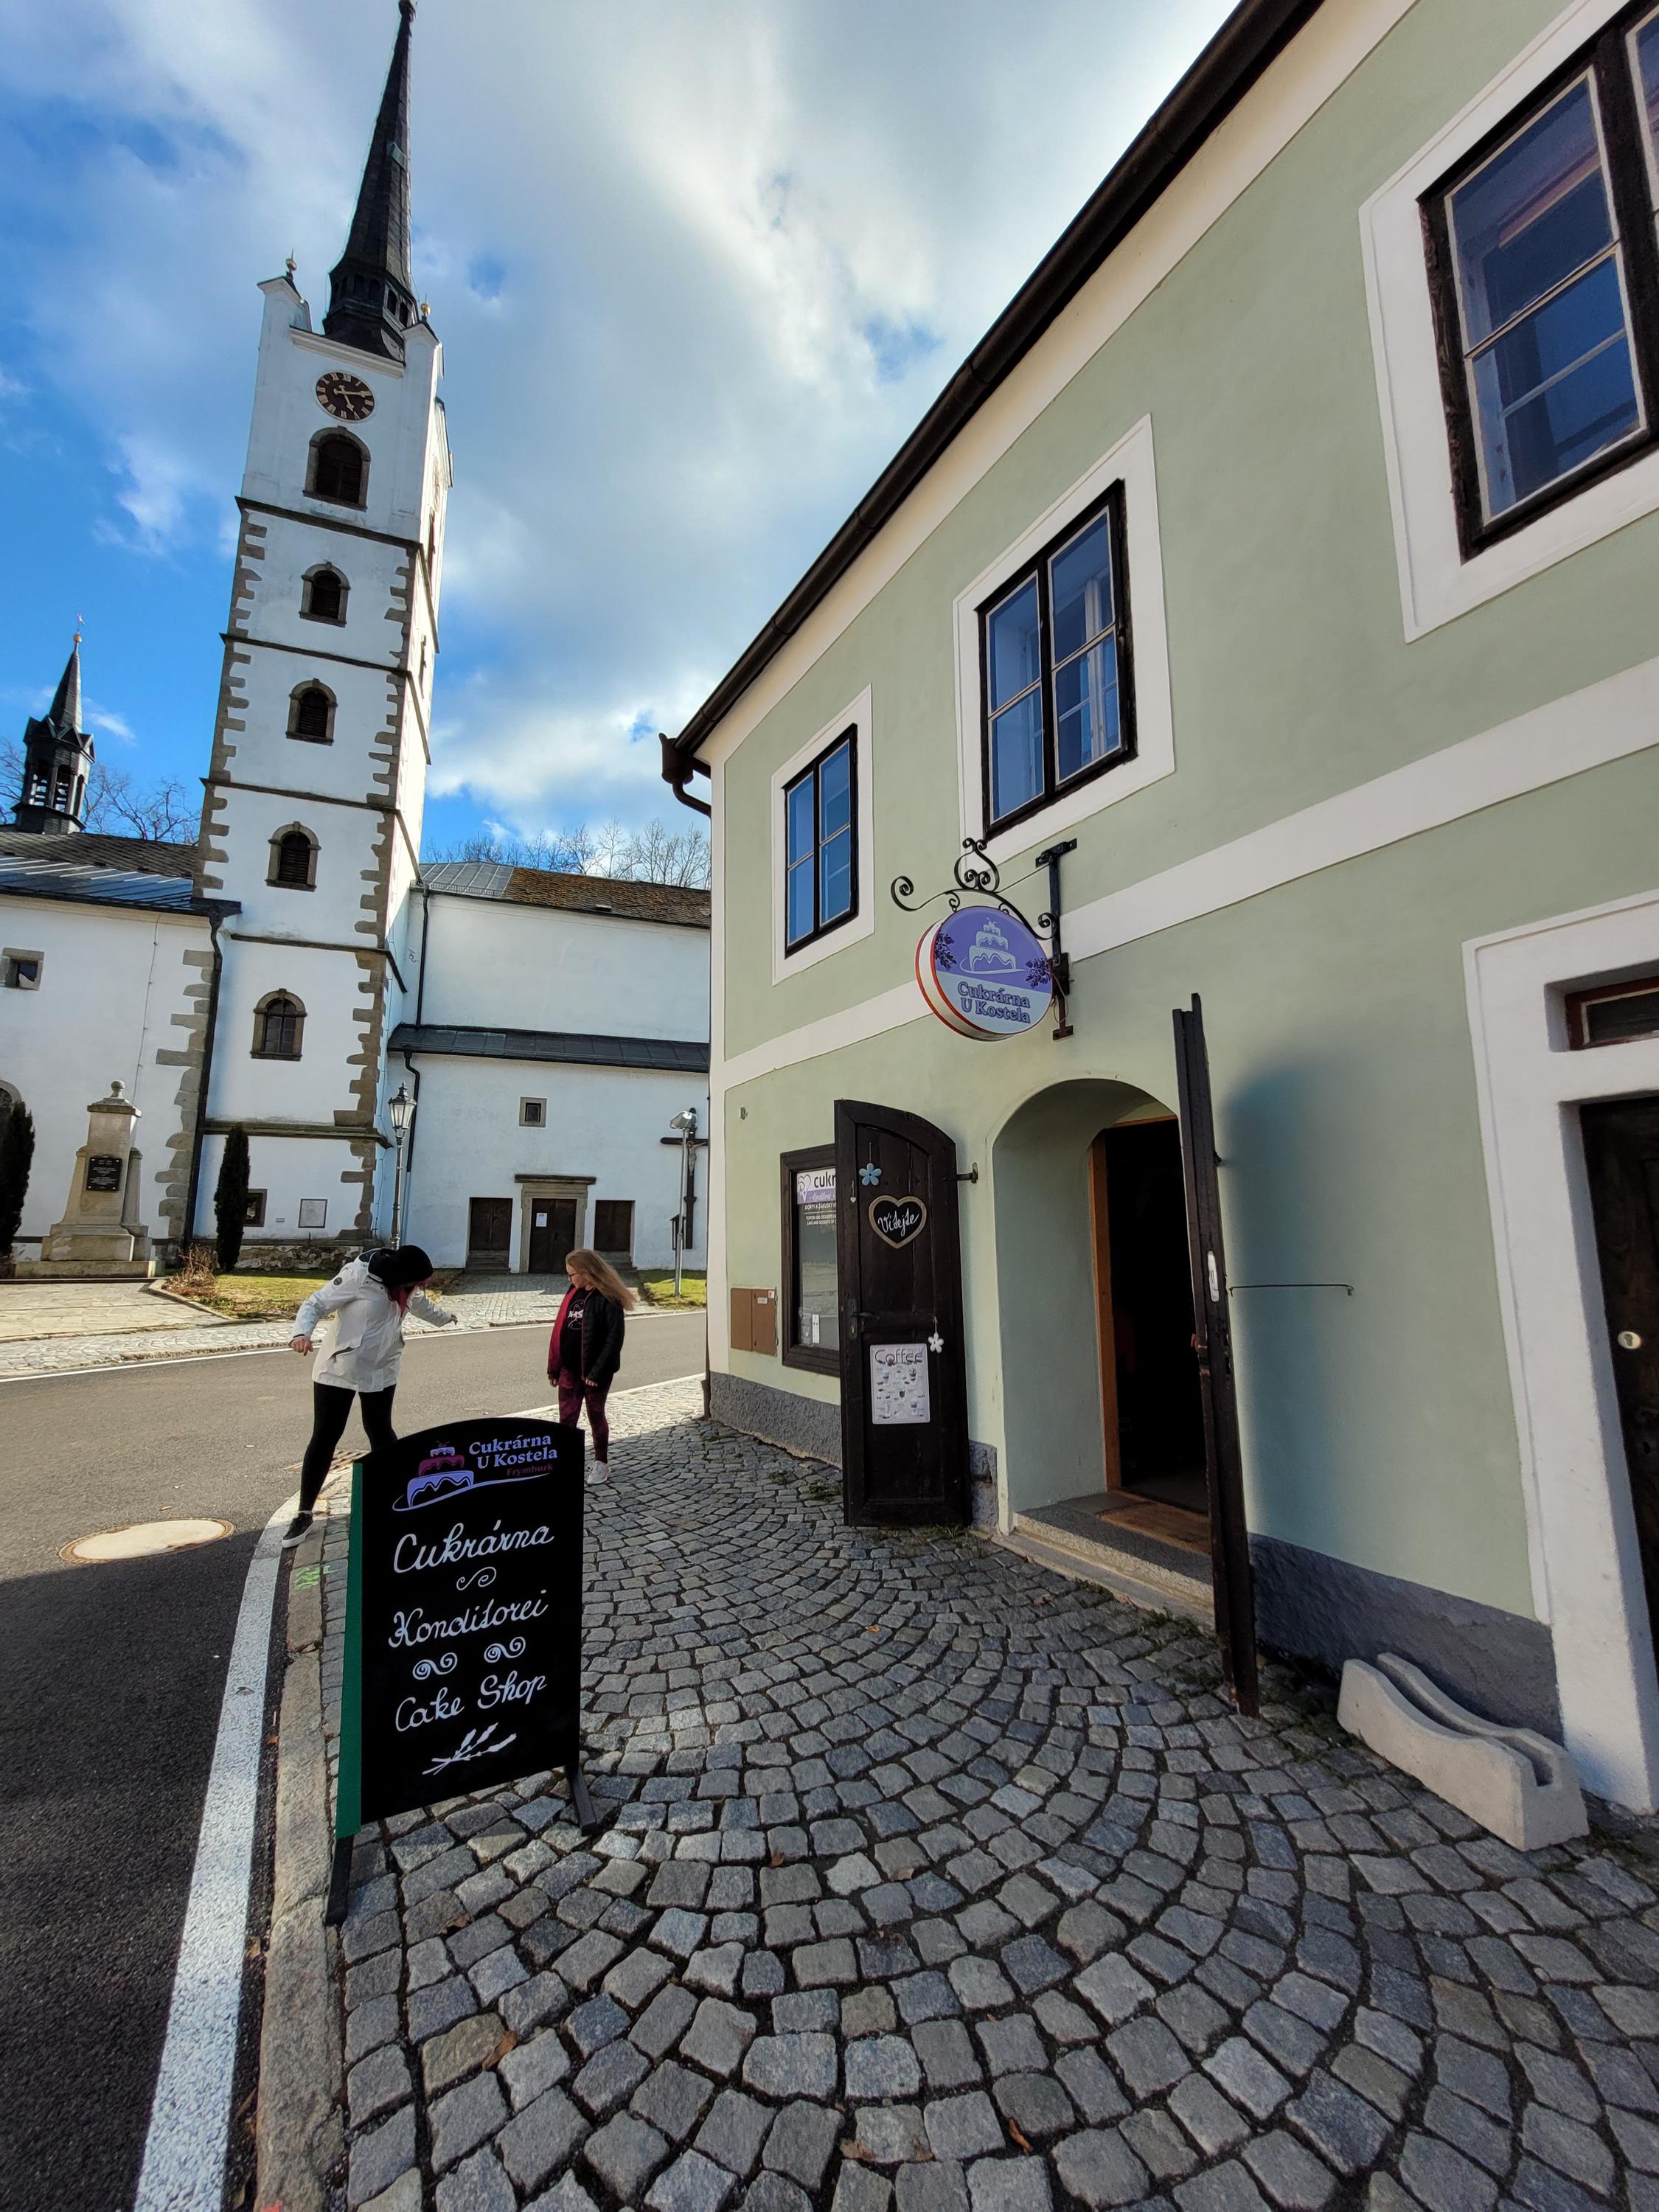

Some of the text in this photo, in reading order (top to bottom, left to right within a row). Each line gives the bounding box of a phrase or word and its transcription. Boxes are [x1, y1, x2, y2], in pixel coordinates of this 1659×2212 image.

[957, 981, 1030, 1008] Cukrárna
[961, 997, 1031, 1023] U Kostela
[875, 1349, 922, 1365] Coffee
[469, 1434, 552, 1455] Cukrárna
[477, 1447, 557, 1469] U Kostela
[507, 1463, 553, 1476] Frymburk
[393, 1520, 554, 1573] Cukrárna
[388, 1589, 549, 1648] Konditorei
[395, 1670, 547, 1731] Cake Shop
